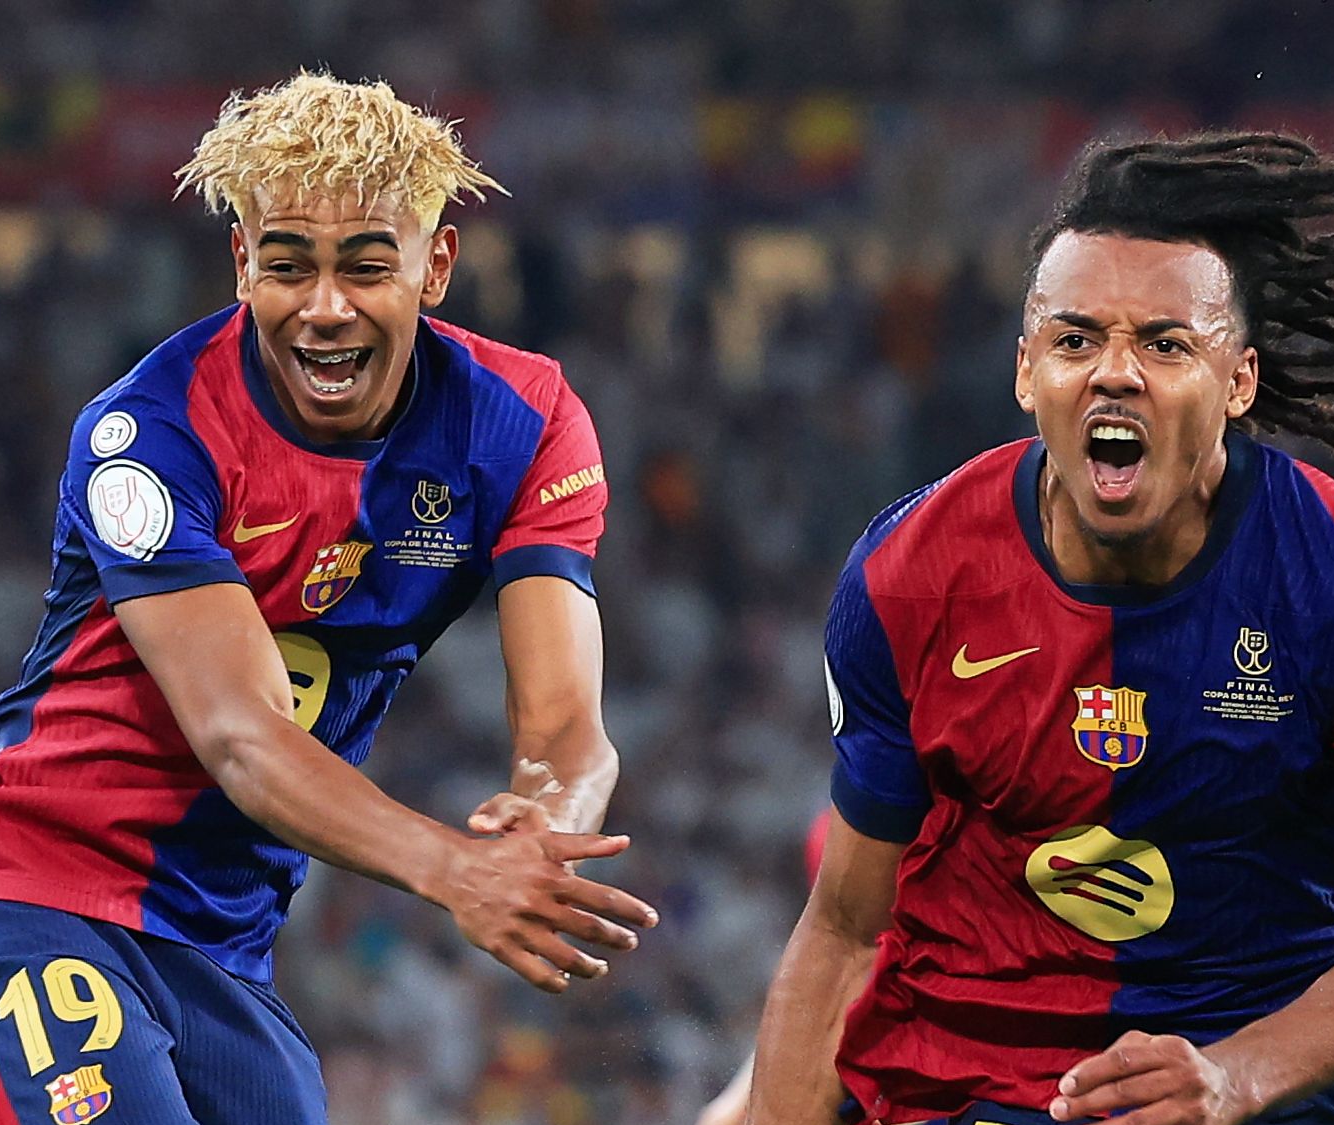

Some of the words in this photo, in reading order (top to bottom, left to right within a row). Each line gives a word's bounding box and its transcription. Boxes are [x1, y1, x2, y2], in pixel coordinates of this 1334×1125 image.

[100, 426, 124, 441] 31
[404, 529, 455, 541] FINAL
[384, 540, 408, 548] COPA
[442, 542, 455, 550] EL
[320, 569, 342, 580] FCB
[1226, 681, 1276, 693] FINAL
[1203, 690, 1230, 700] COPA
[1230, 693, 1245, 701] DE
[1267, 695, 1277, 703] EL
[1278, 694, 1295, 703] REY
[1097, 719, 1128, 732] FCB
